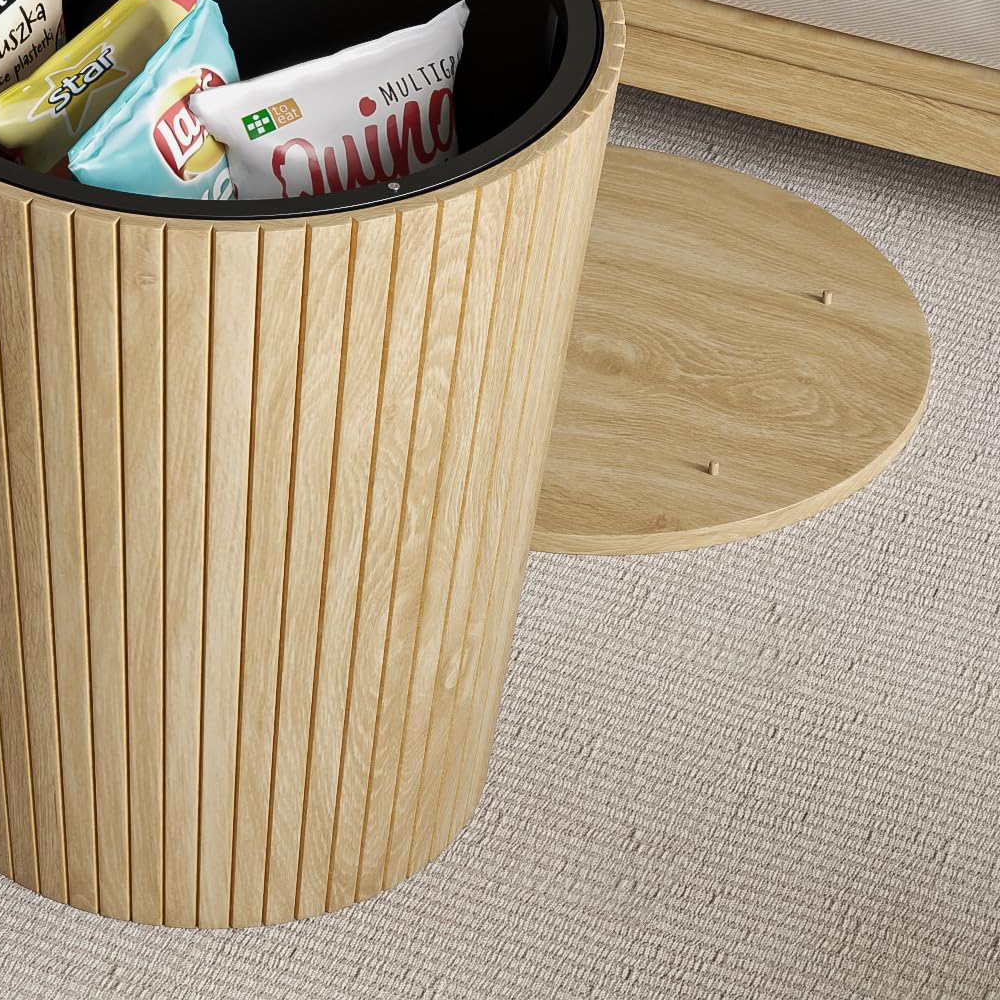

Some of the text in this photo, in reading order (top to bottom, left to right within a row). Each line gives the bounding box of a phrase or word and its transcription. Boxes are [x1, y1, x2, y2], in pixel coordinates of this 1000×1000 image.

[14, 28, 53, 81] plasterki
[48, 48, 113, 113] star
[378, 52, 461, 106] MULTIGR
[272, 105, 287, 116] to
[278, 108, 300, 123] eat
